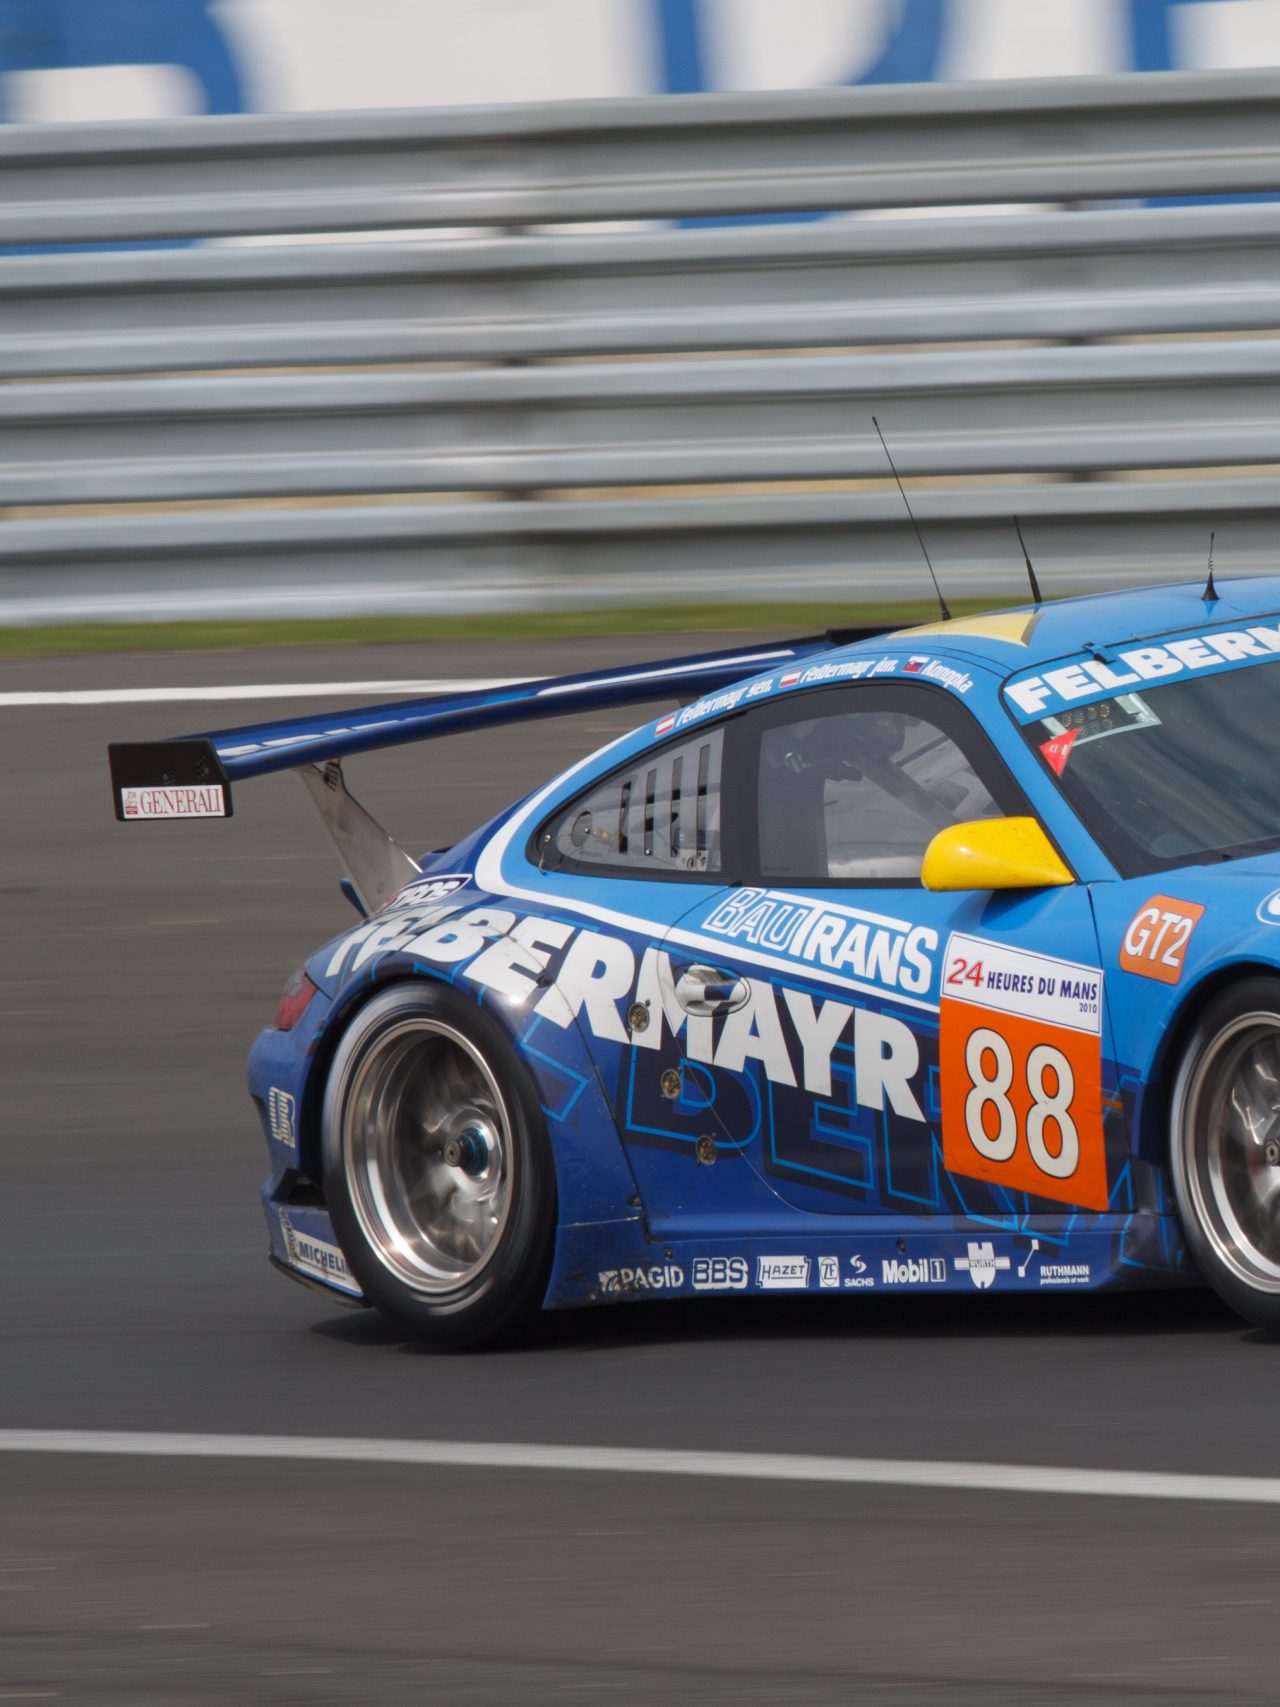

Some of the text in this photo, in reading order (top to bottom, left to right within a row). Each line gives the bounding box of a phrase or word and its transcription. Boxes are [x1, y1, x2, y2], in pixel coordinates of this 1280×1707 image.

[921, 660, 974, 694] Konopka
[140, 788, 222, 814] GENERALI
[701, 887, 939, 994] BAUTRANS
[1124, 907, 1193, 968] GT2
[946, 958, 1098, 1001] 24 HEURES DU MANS
[325, 905, 926, 1122] FELBERMAYR
[1079, 1002, 1098, 1014] 2010
[965, 1026, 1080, 1180] 88
[621, 1265, 684, 1289] PAGID
[692, 1257, 749, 1289] BBS
[762, 1263, 806, 1280] HAZET
[844, 1277, 874, 1287] SACHS
[882, 1258, 928, 1284] Mobil
[1040, 1265, 1090, 1276] RUTHMANN
